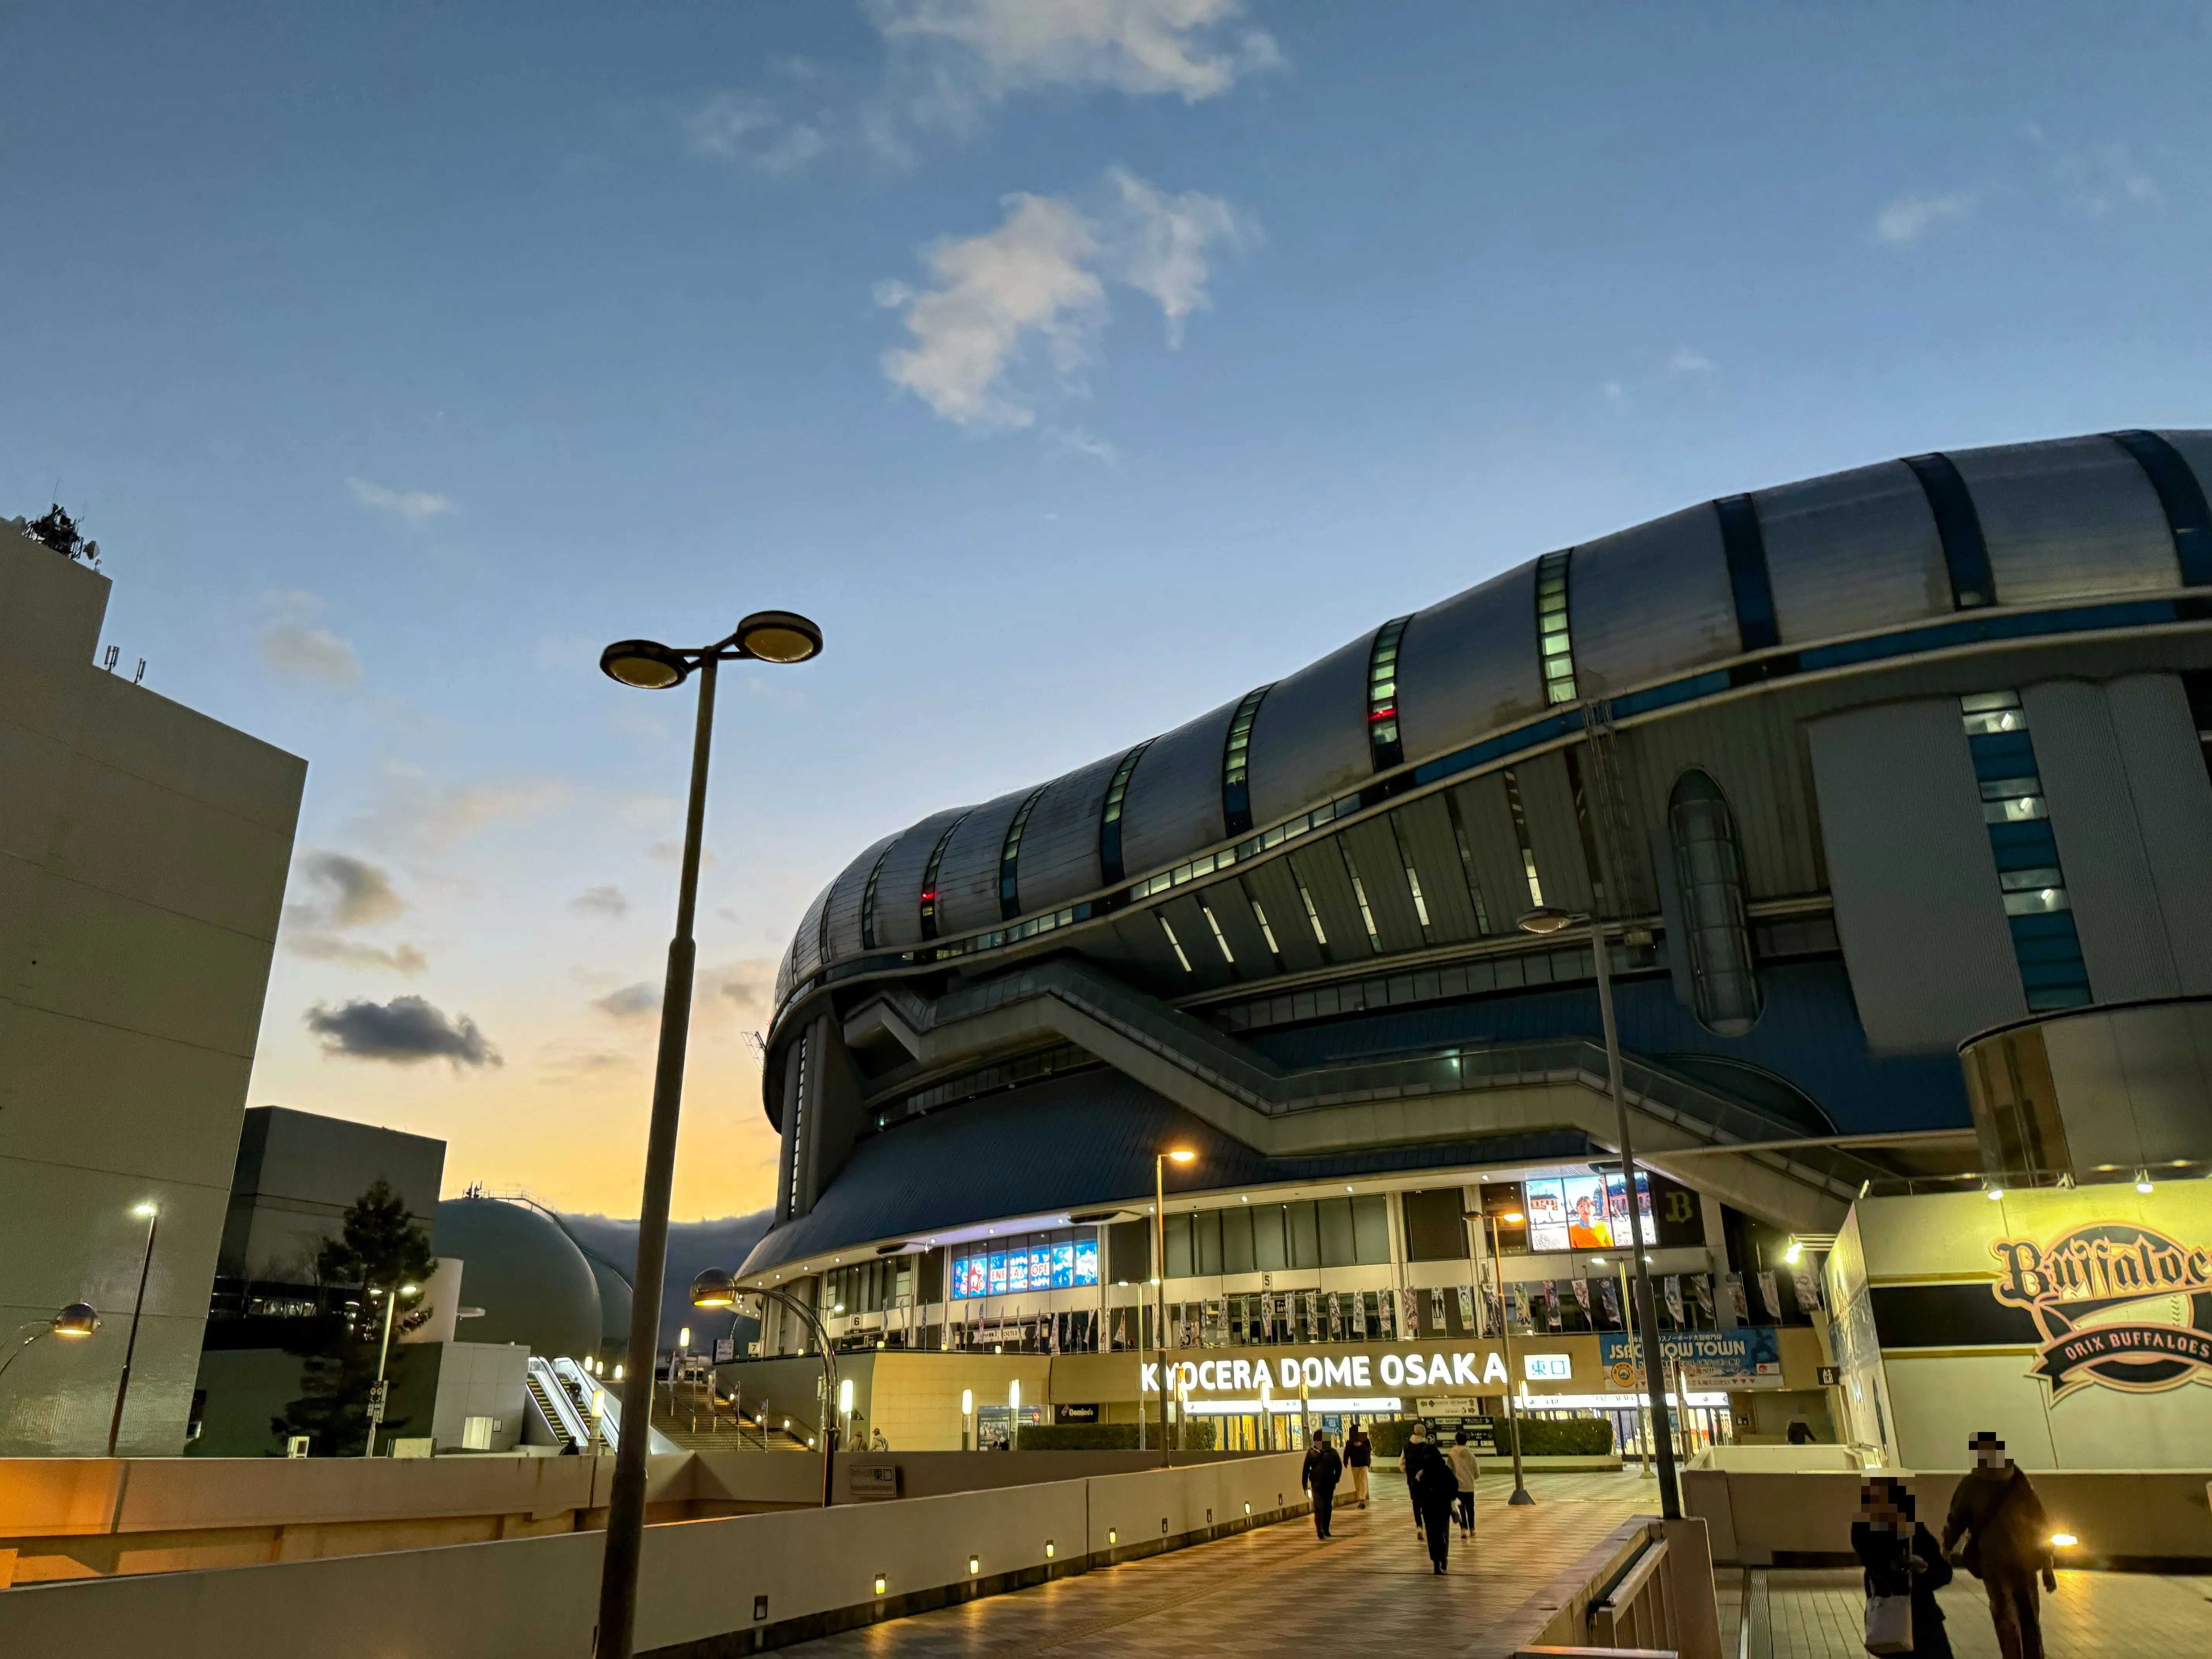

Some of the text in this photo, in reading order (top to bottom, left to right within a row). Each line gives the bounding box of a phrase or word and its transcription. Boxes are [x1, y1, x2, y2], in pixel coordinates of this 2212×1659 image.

[1666, 1191, 1693, 1224] B
[1993, 1234, 2212, 1303] Buffaloe
[1265, 1275, 1269, 1286] 5
[854, 1317, 860, 1326] 6
[1695, 1340, 1746, 1357] TOWN
[2065, 1331, 2210, 1360] ORIX BUFFALOES
[1141, 1352, 1508, 1391] KYOCERA DOME OSAKA
[1532, 1360, 1565, 1376] 東口
[1069, 1408, 1094, 1416] Domino's
